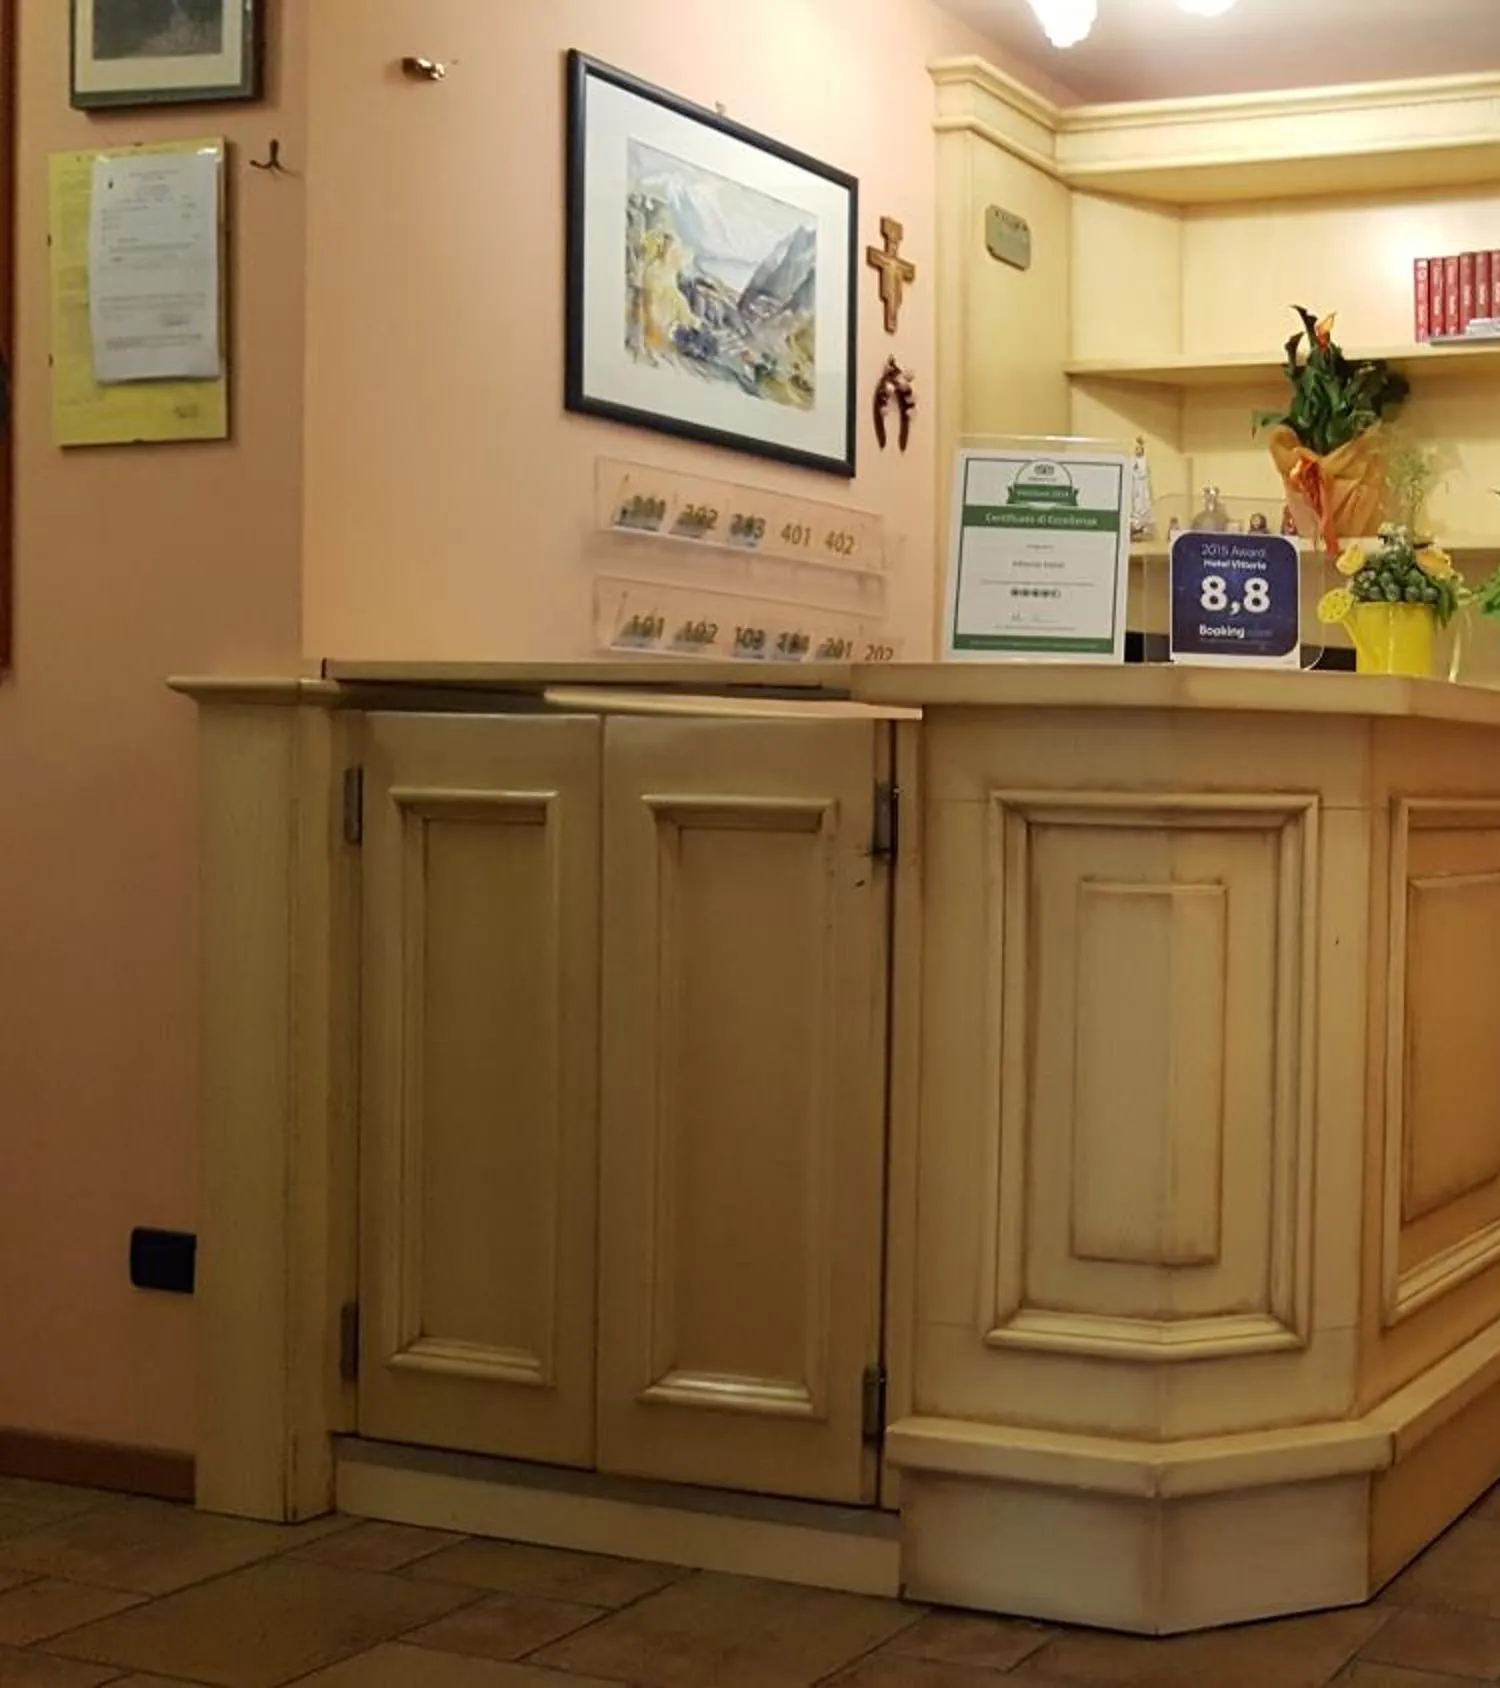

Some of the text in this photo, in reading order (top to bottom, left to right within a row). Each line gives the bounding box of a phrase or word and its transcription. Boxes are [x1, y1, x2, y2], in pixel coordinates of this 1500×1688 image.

[780, 523, 811, 548] 401
[824, 529, 855, 556] 402
[1231, 544, 1267, 558] Award
[1203, 559, 1230, 570] Hotel
[1200, 575, 1271, 615] 8,8
[1199, 623, 1272, 639] Booking
